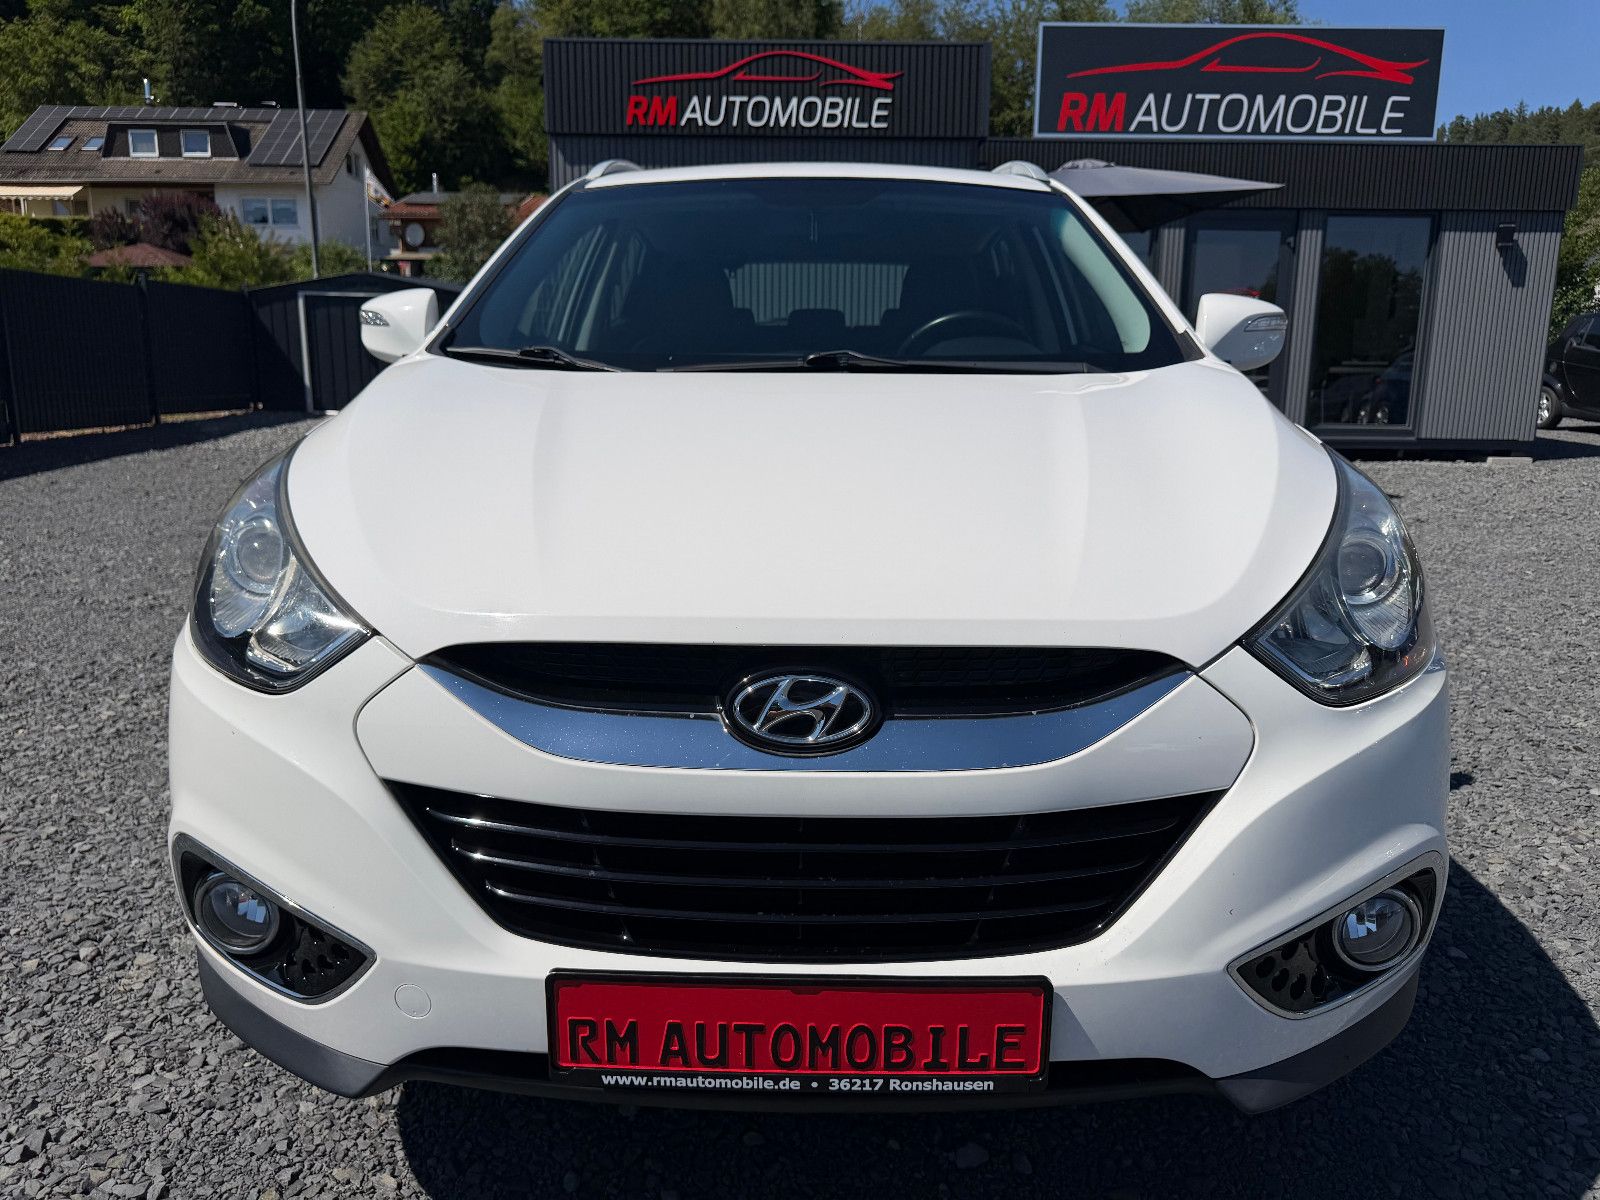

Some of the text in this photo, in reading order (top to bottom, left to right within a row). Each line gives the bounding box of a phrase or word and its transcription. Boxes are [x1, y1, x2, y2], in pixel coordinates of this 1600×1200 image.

[626, 96, 892, 128] RM AUTOMOBILE
[1057, 92, 1410, 134] RM AUTOMOBILE
[567, 1017, 1025, 1070] RM AUTOMOBILE
[601, 1073, 994, 1091] www.rmautomobile.de 36217 Ronshausen
